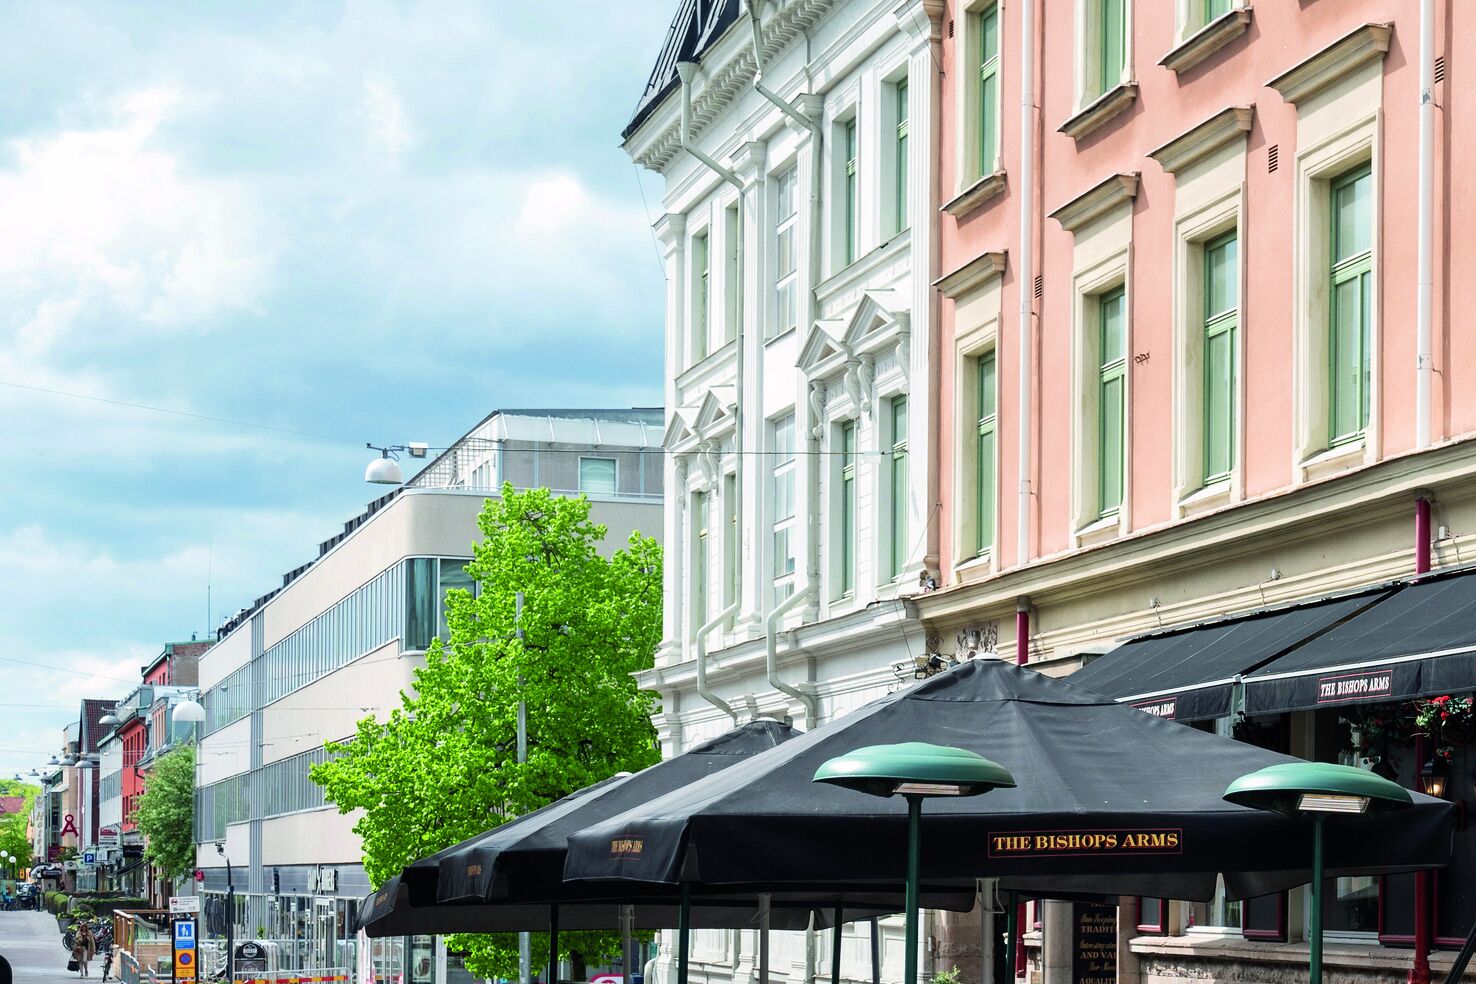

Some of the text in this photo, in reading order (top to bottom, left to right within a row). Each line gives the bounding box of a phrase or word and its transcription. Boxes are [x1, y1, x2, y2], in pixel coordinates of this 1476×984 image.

[1321, 677, 1390, 697] THE BISHOPS ARMS
[993, 833, 1178, 850] THE BISHOPS ARMS
[1080, 951, 1099, 959] AND
